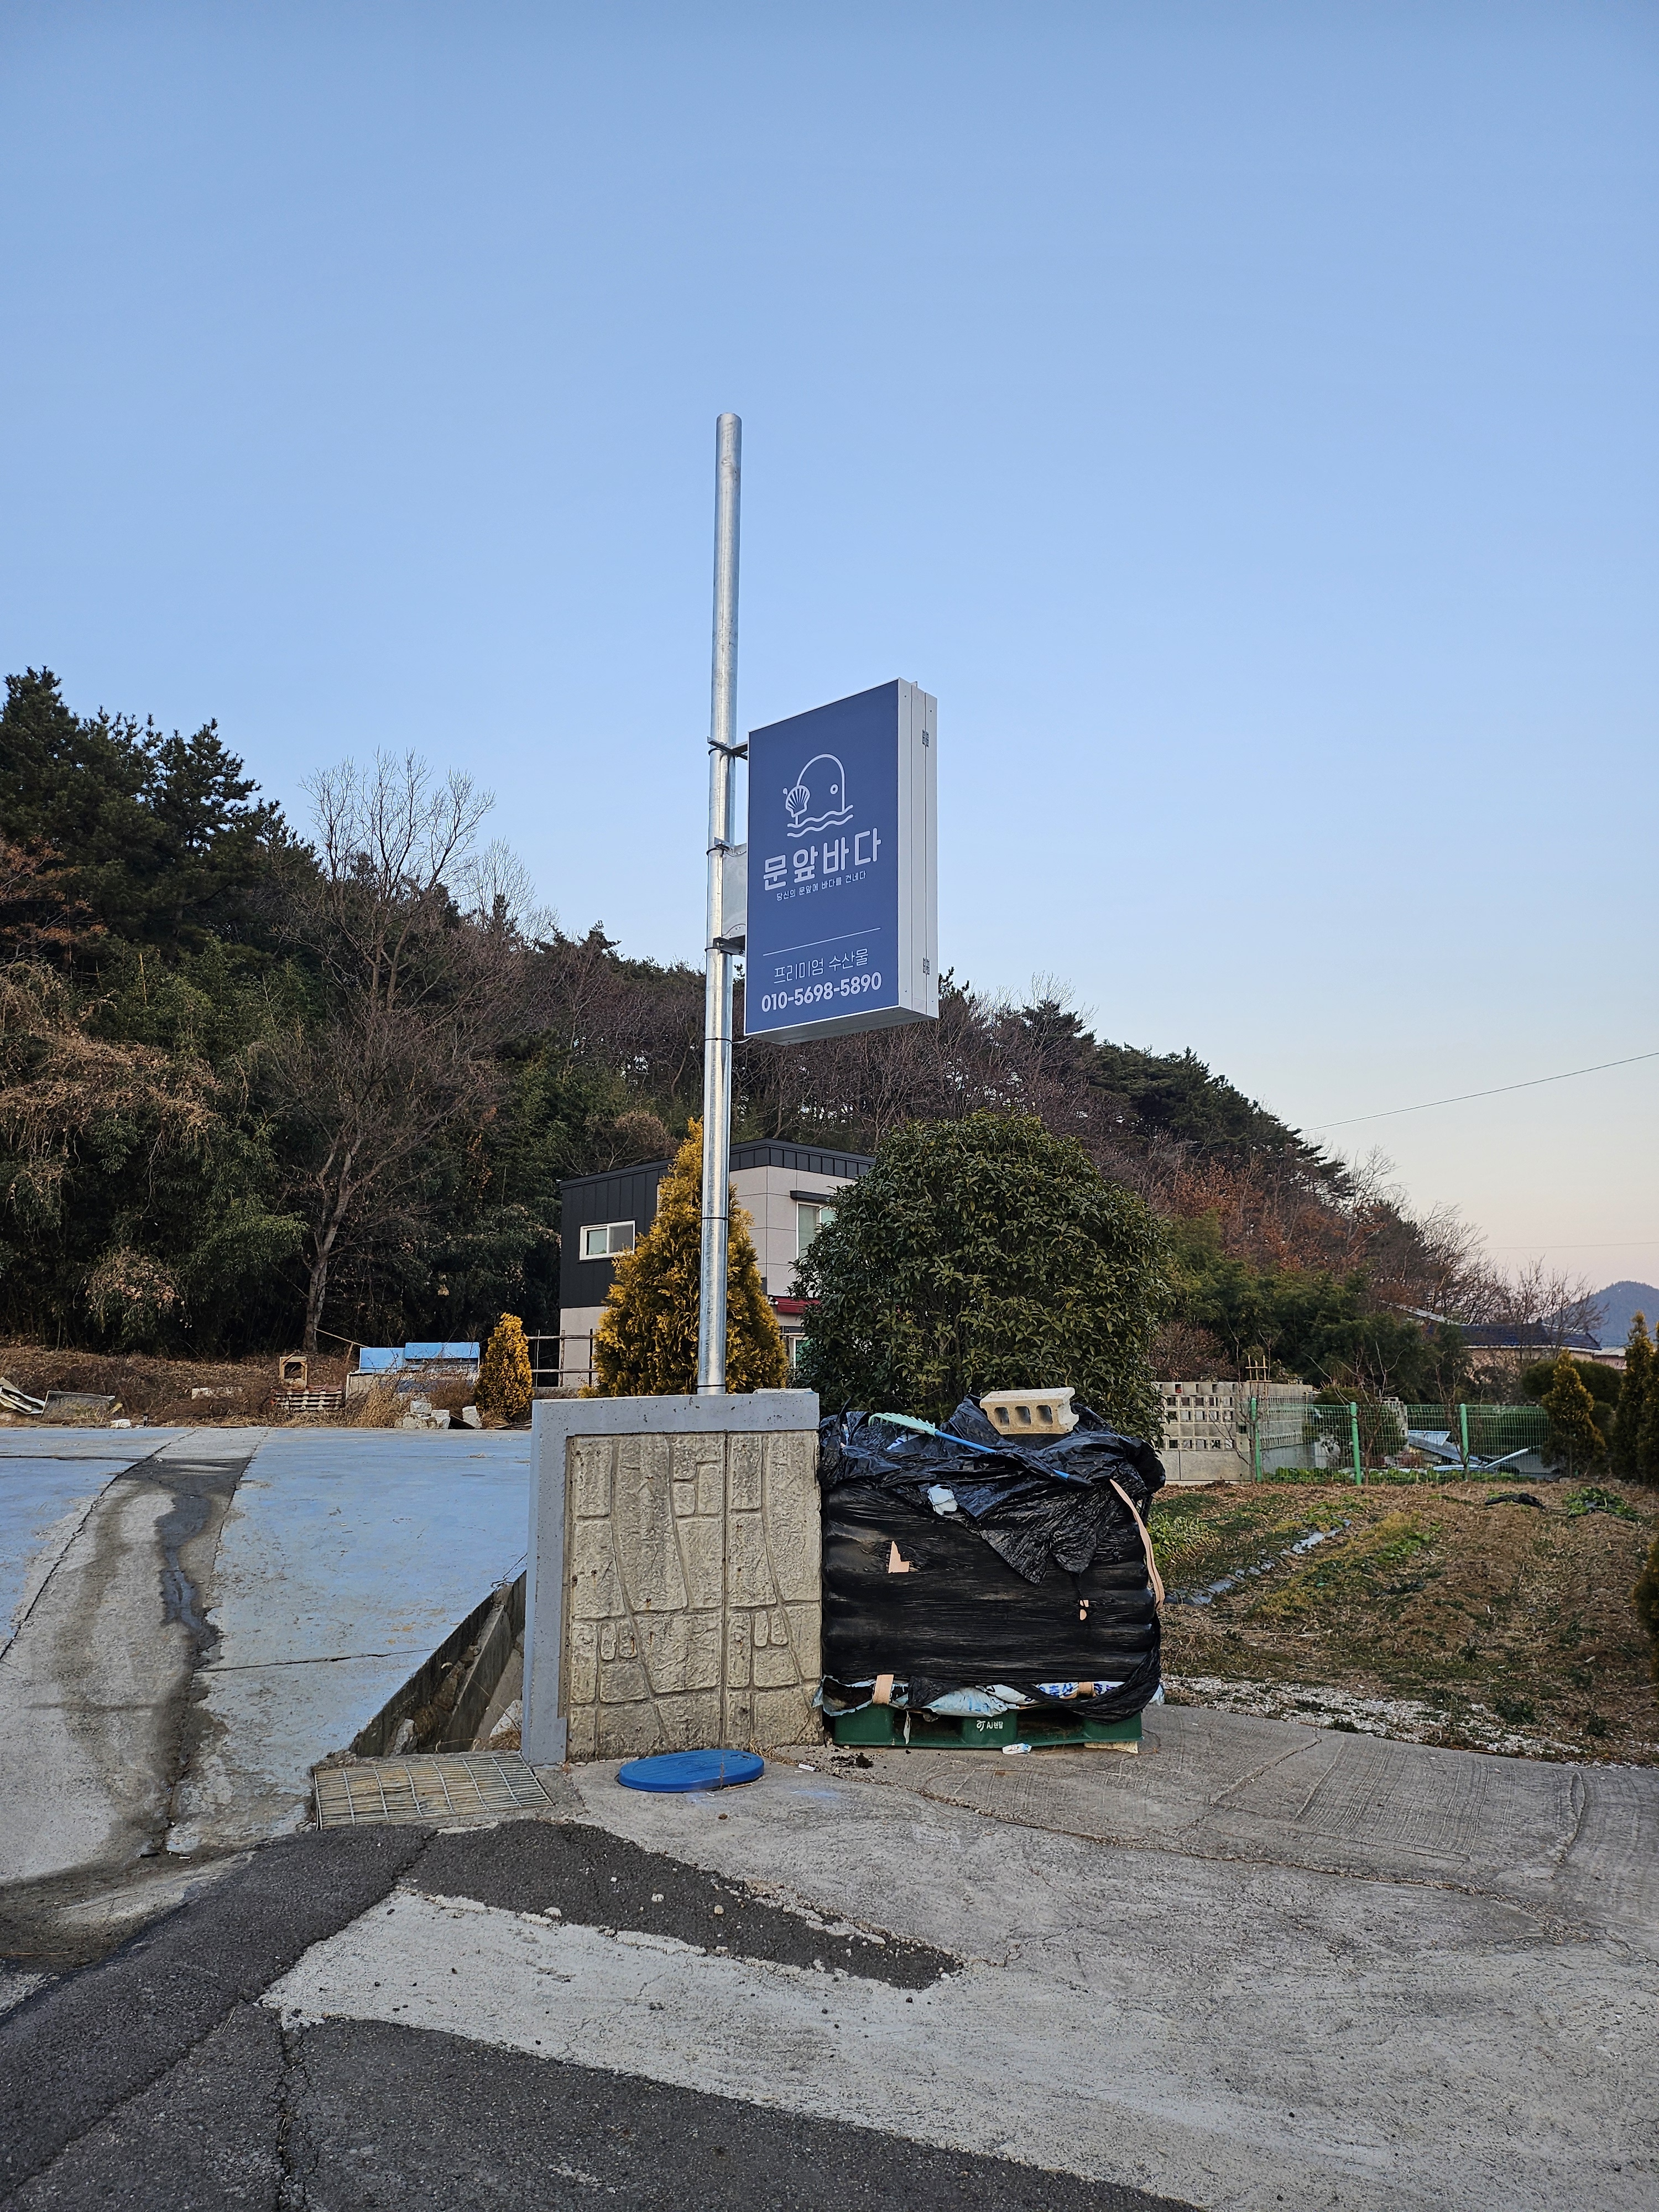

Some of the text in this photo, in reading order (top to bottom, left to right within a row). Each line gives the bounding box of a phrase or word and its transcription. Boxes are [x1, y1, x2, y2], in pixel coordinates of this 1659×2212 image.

[763, 828, 881, 891] 문앞바다
[776, 870, 867, 901] 당신의 문앞에 바다를 건네다
[774, 948, 869, 984] 프리미엄 수산물
[761, 972, 882, 1013] 010-5698-5890
